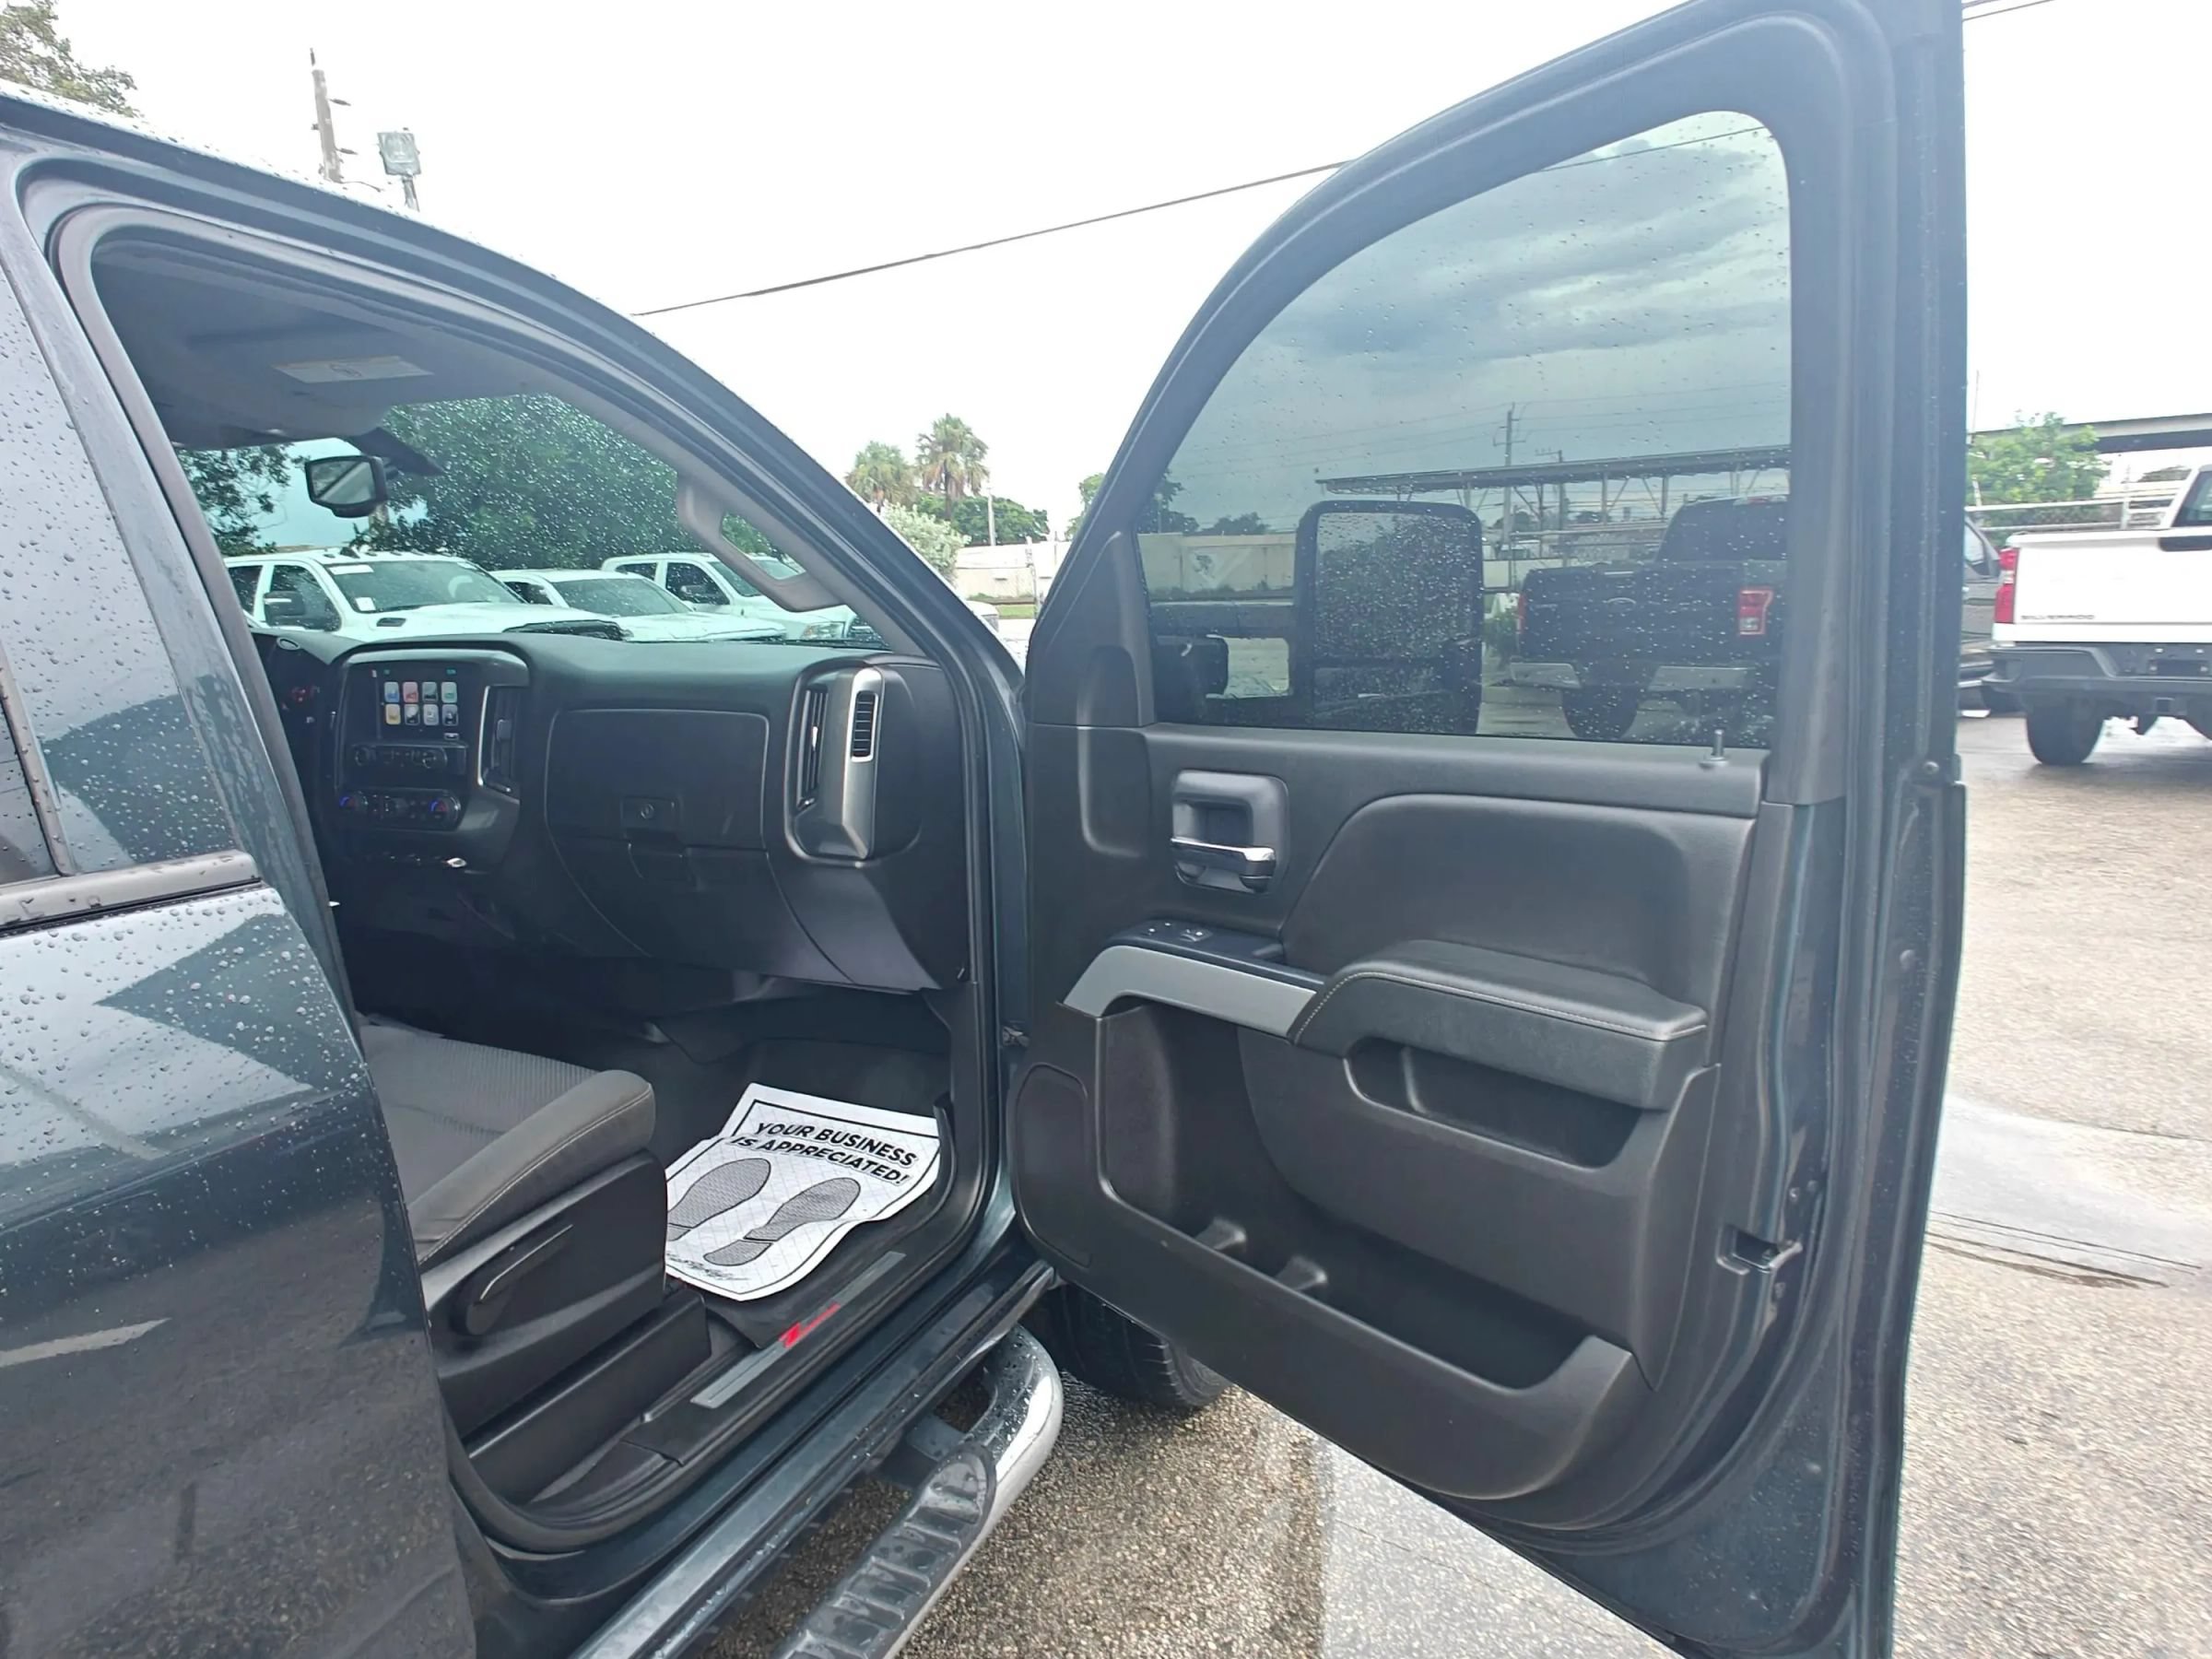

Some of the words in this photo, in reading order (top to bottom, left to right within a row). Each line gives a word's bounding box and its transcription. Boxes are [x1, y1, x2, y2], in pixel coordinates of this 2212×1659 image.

[731, 1136, 759, 1147] IS
[757, 1139, 911, 1184] APPRECIATED!
[755, 1123, 816, 1137] YOUR
[815, 1129, 918, 1166] BUSINESS
